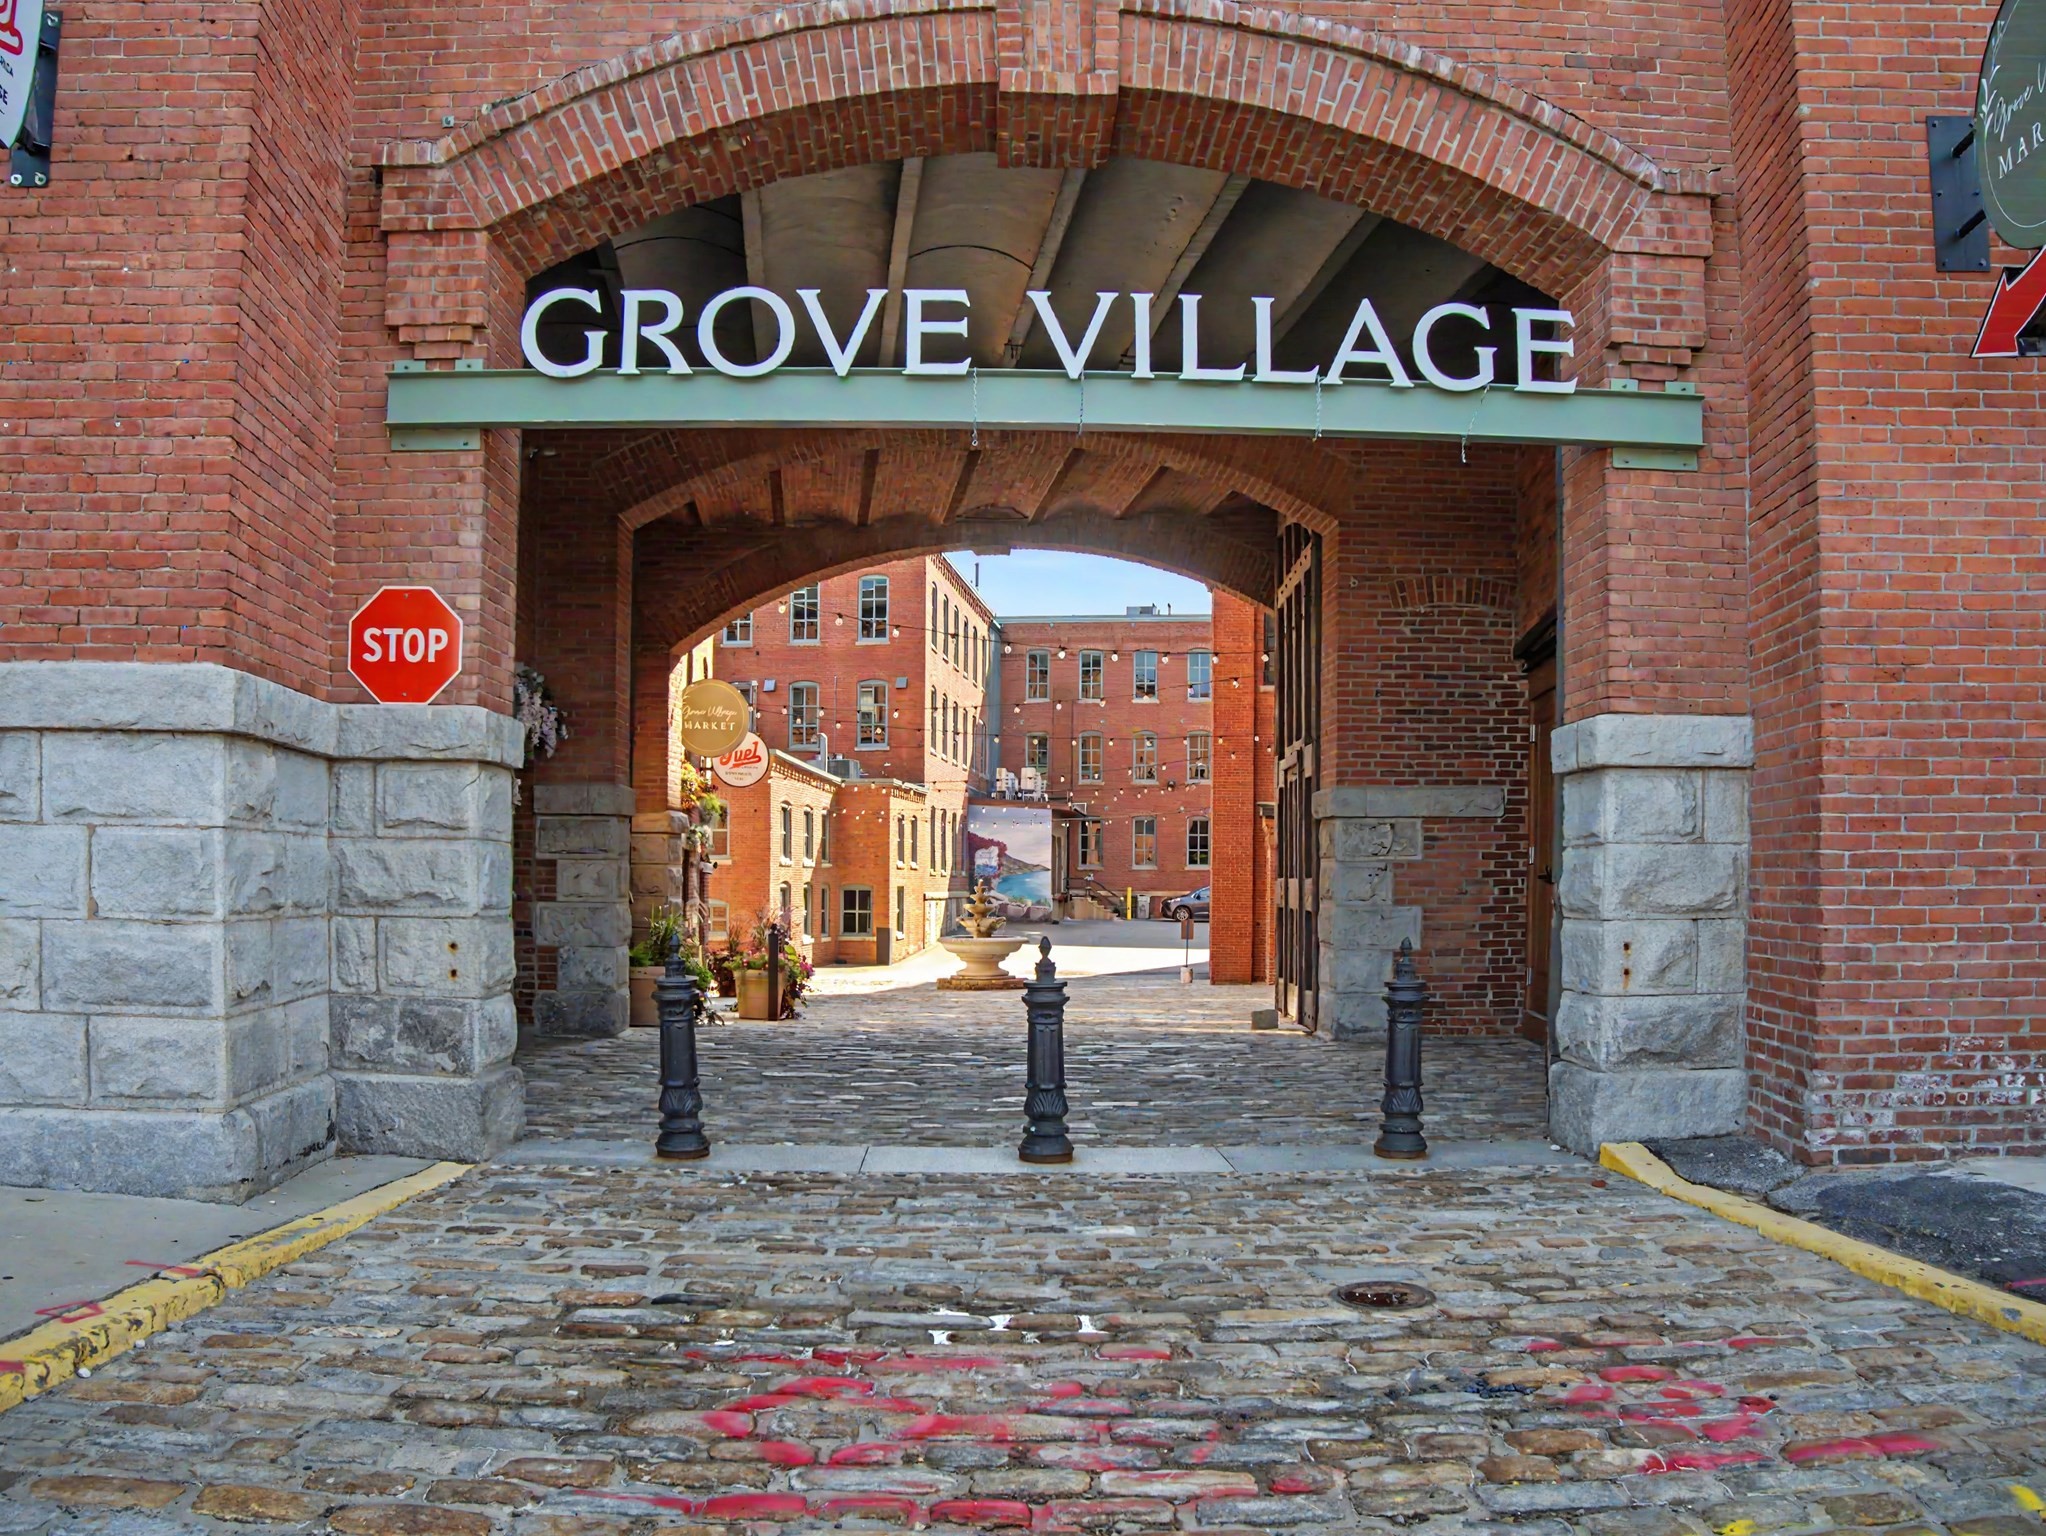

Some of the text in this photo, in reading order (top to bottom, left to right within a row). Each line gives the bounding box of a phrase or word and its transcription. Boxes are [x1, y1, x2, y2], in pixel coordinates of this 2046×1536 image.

[521, 286, 1578, 394] GROVE VILLAGE
[361, 627, 449, 663] STOP
[684, 720, 736, 731] MARKET
